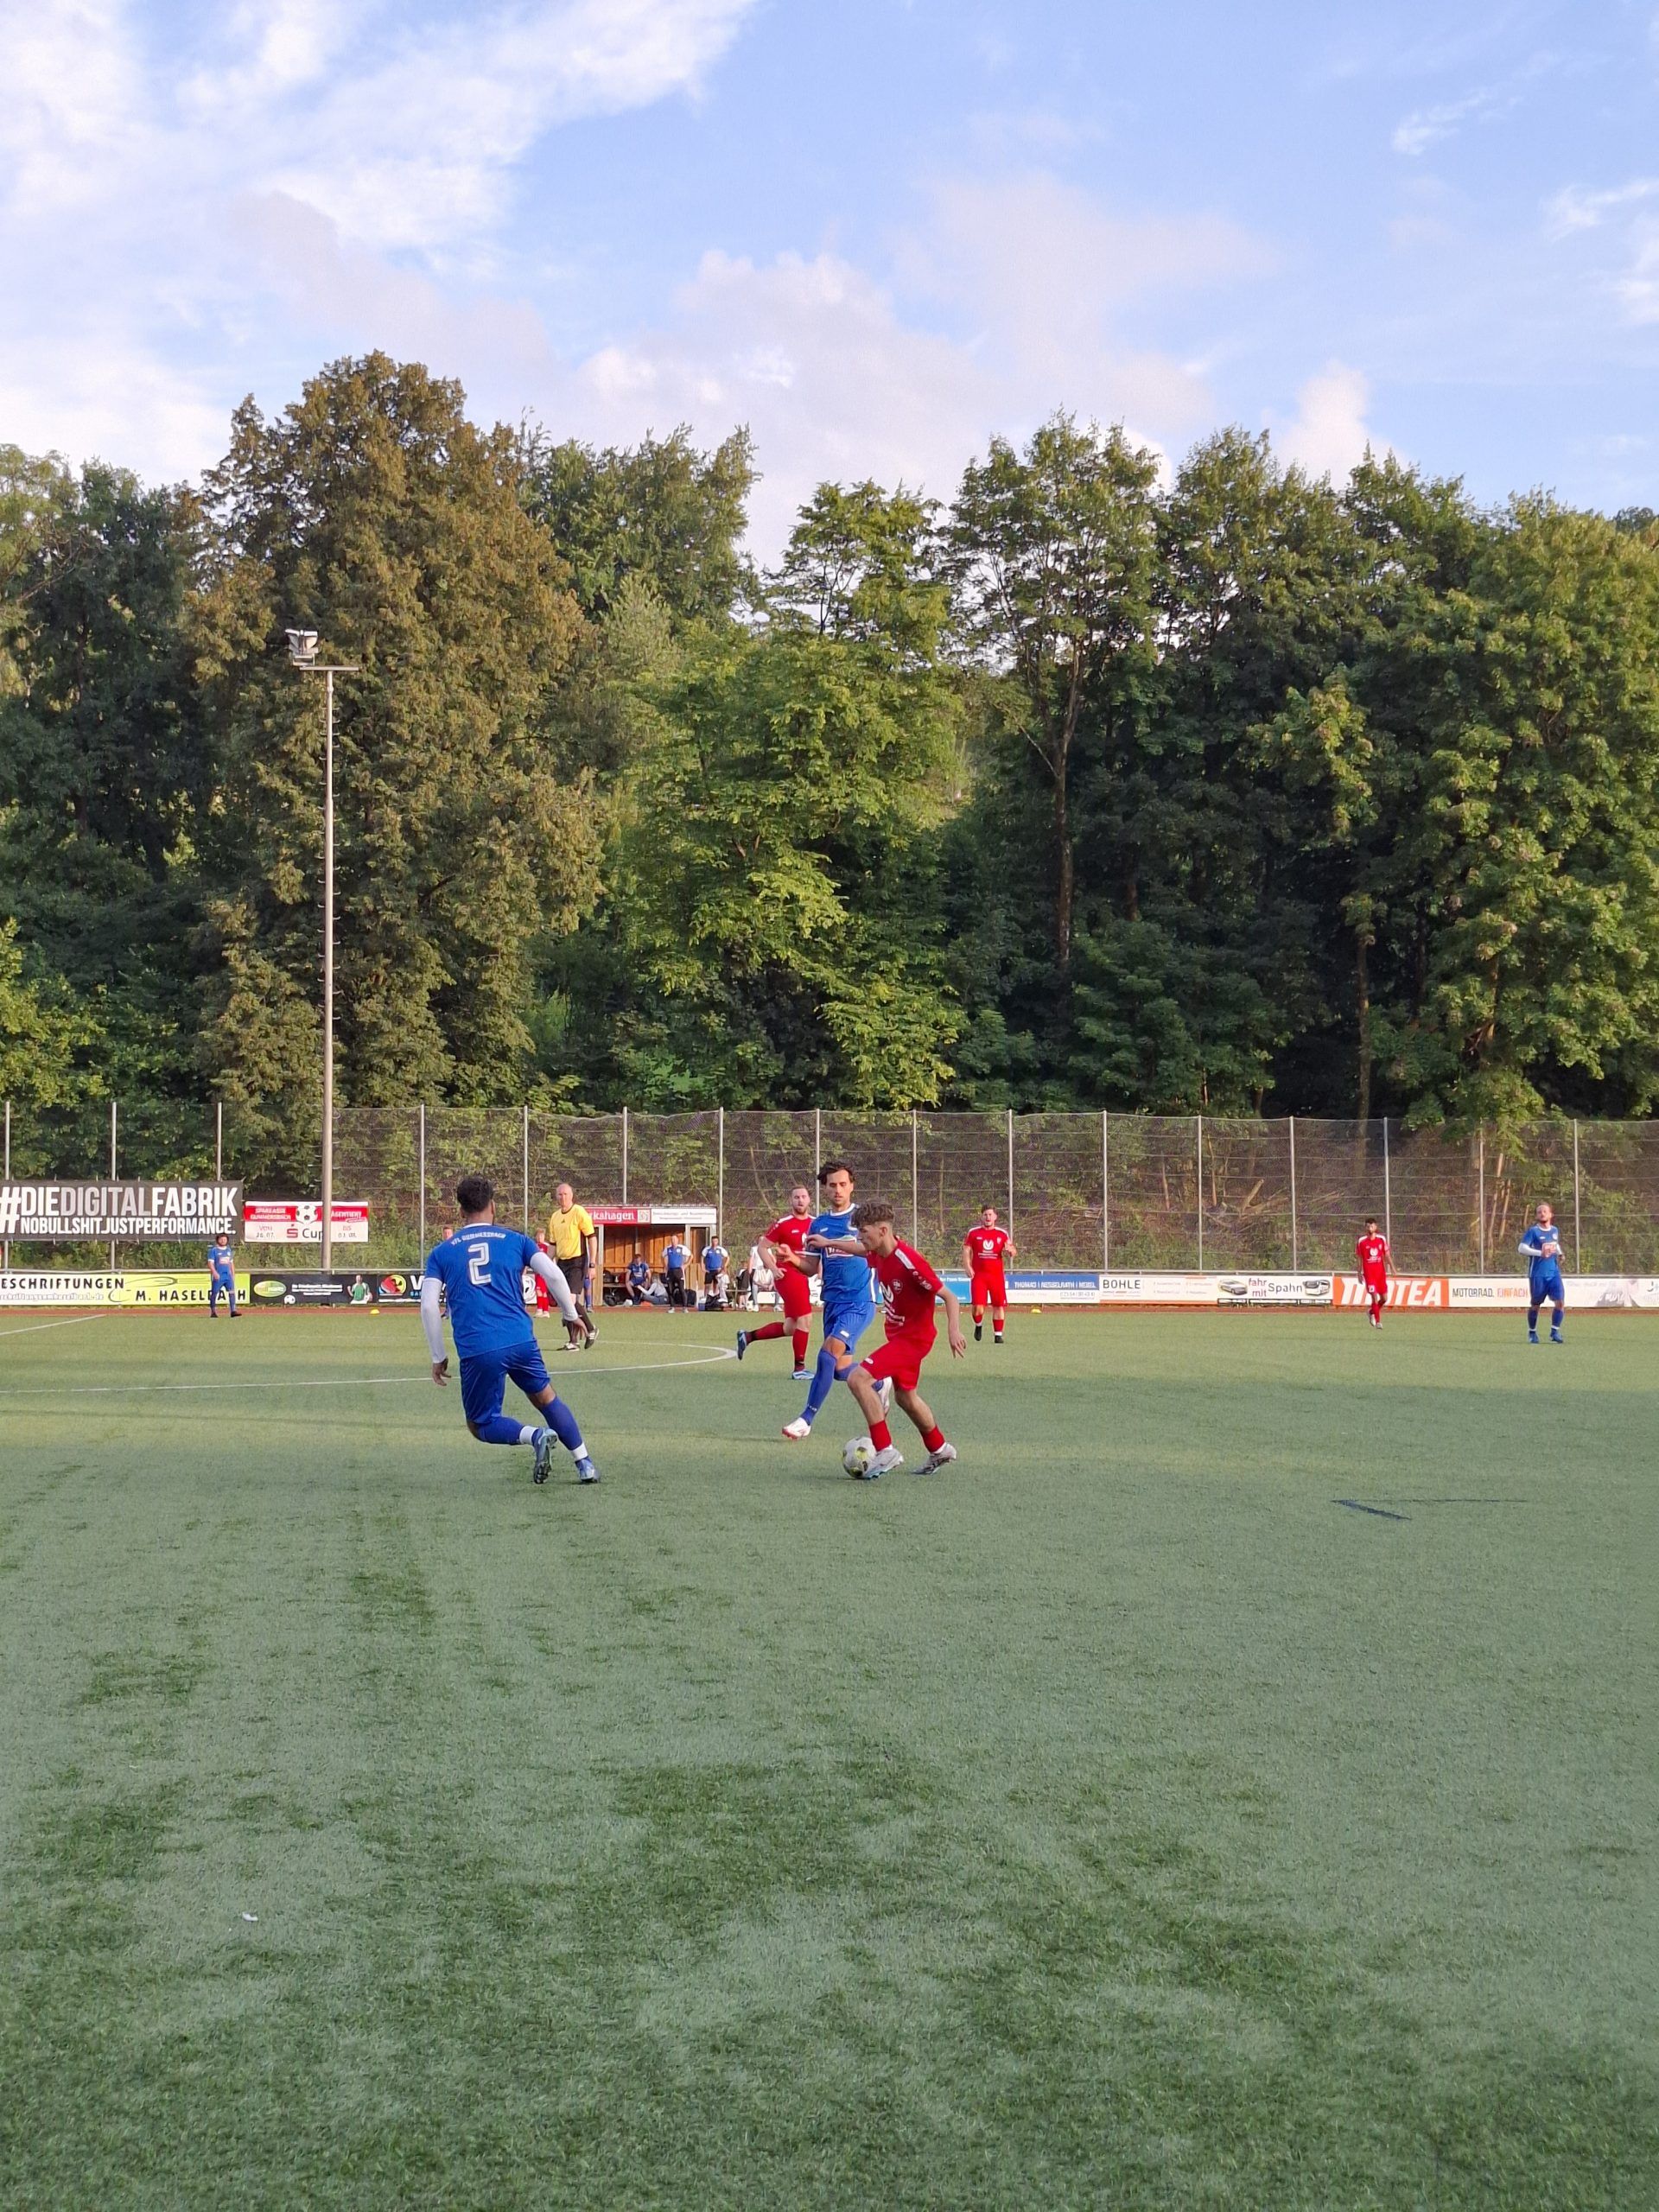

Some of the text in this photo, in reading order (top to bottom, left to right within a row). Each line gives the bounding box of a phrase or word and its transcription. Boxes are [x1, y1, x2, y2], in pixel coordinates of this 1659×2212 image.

[0, 1186, 238, 1233] #DIEDIGITALFABRIK
[467, 1242, 492, 1285] 2
[1103, 1279, 1141, 1289] BOHLE
[1249, 1277, 1268, 1287] fahr
[1268, 1282, 1303, 1294] Spahn
